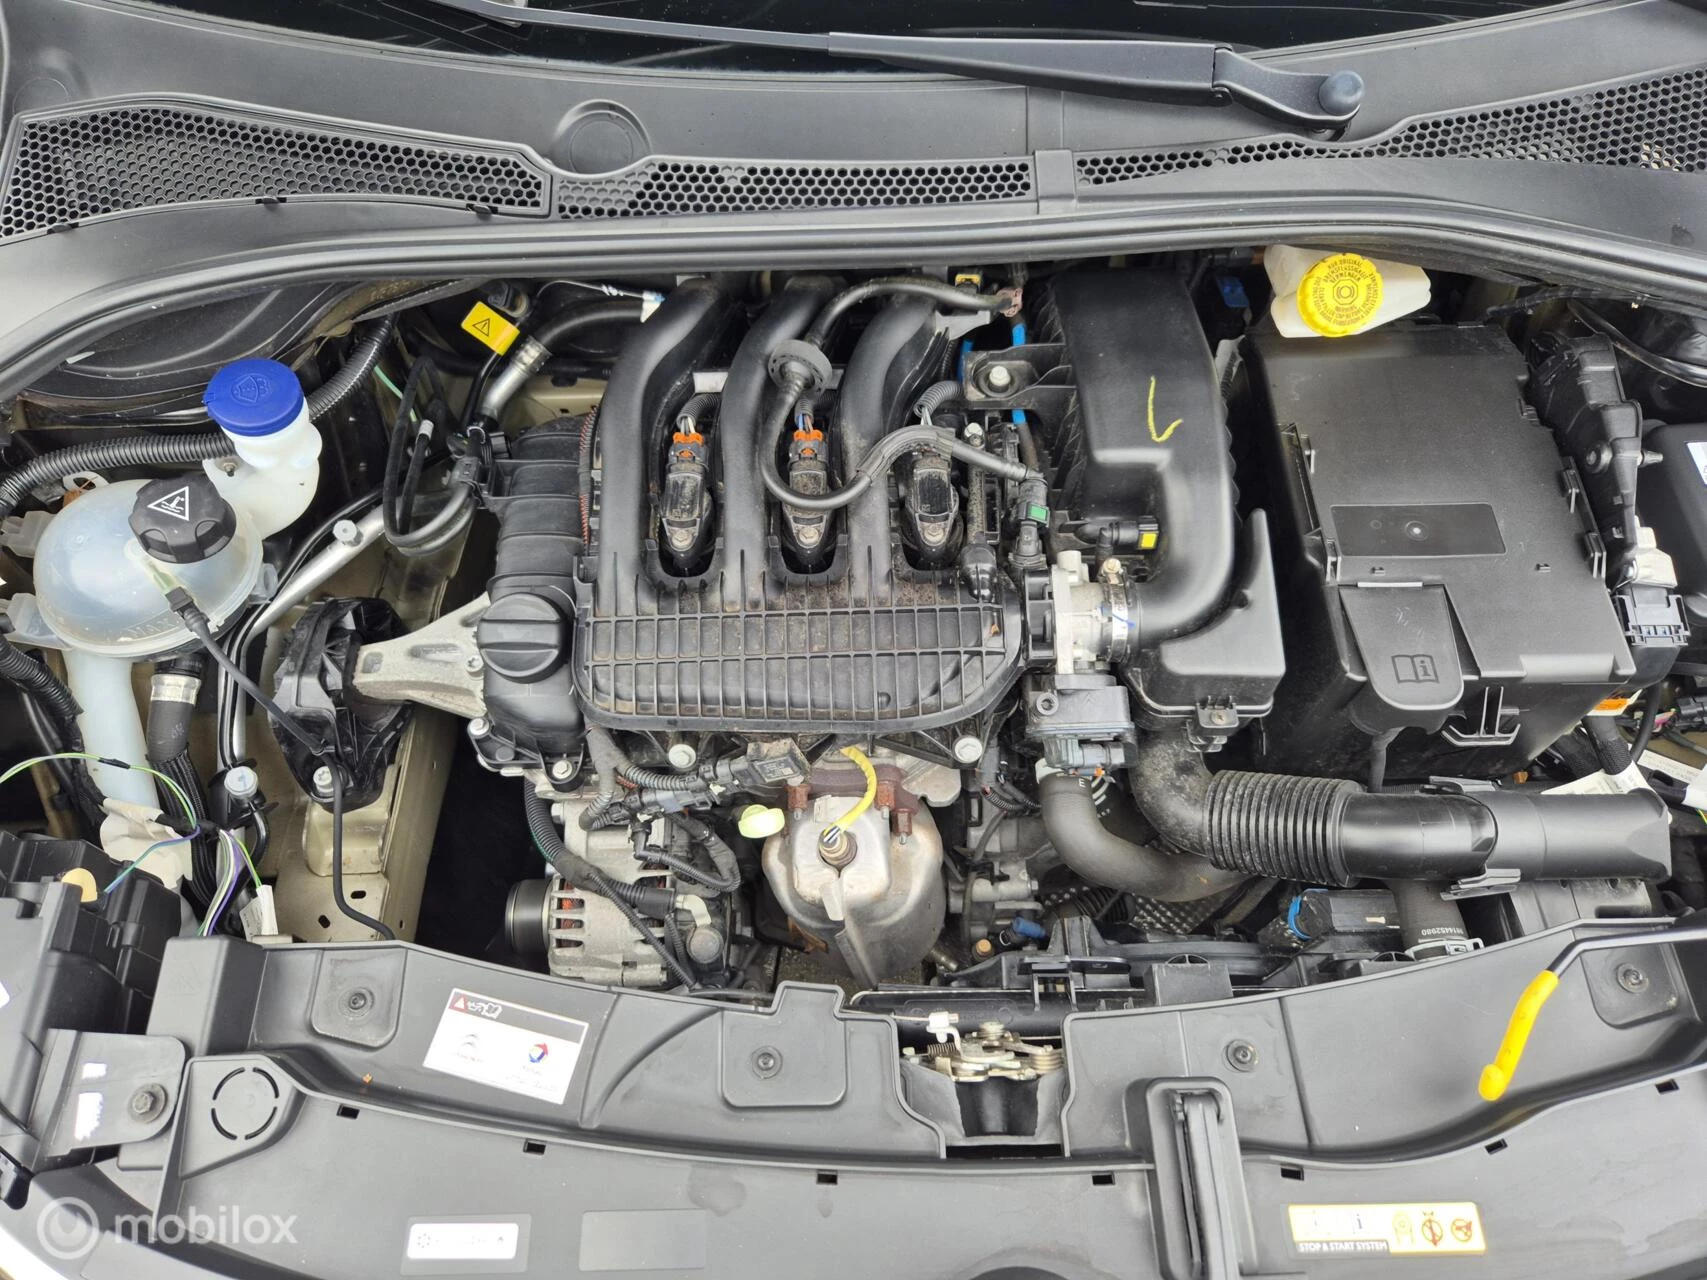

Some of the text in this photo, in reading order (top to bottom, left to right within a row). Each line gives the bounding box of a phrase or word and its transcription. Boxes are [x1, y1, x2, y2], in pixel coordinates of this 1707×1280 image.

[1298, 1242, 1321, 1252] STOP
[1330, 1241, 1354, 1252] START
[1356, 1240, 1388, 1251] SYSTEM
